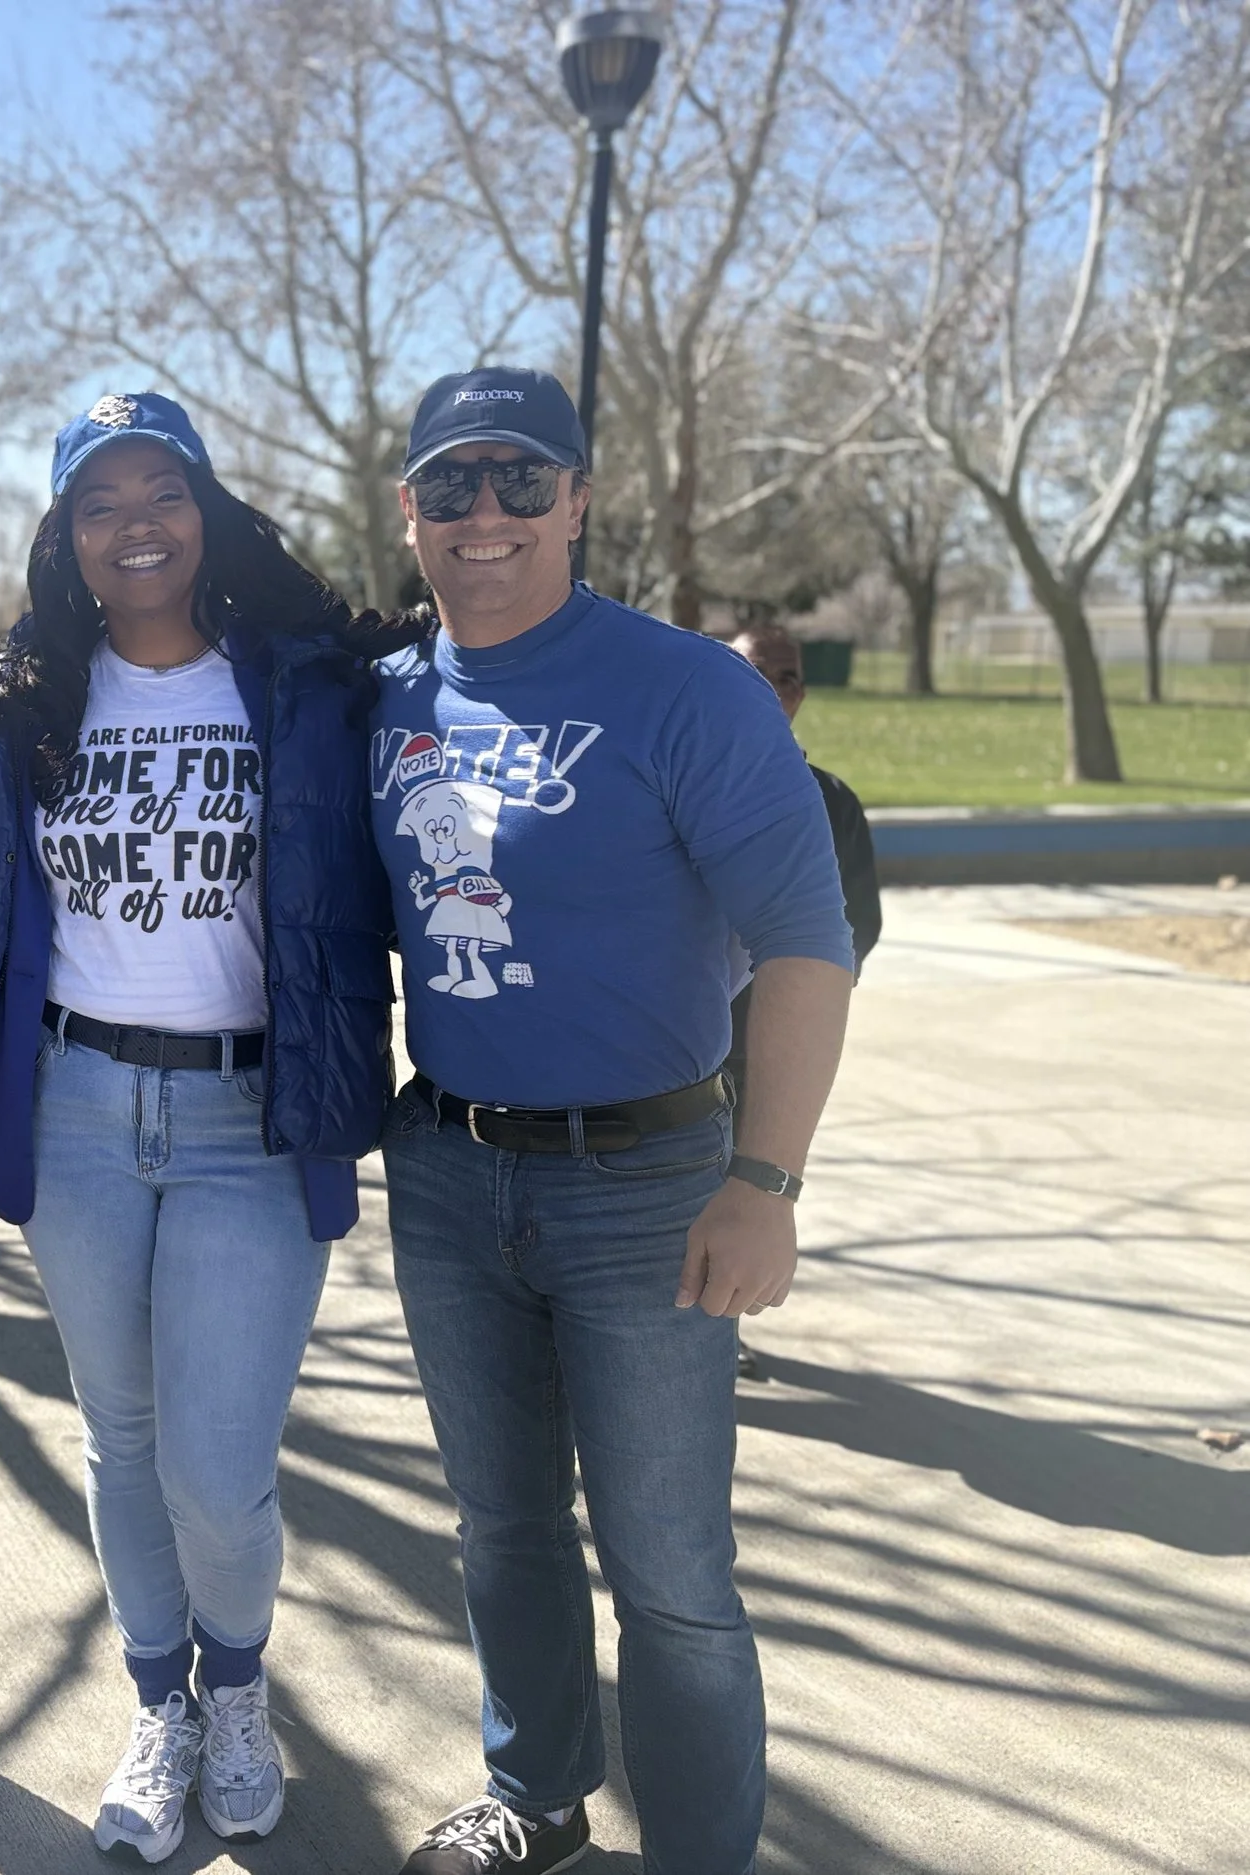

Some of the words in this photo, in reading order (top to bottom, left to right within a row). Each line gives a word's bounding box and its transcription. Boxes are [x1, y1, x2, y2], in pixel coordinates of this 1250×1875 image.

[86, 727, 126, 746] ARE
[68, 750, 157, 796] OME
[177, 746, 262, 796] FOR
[400, 750, 438, 775] VOTE
[43, 795, 118, 829] one
[130, 784, 183, 835] of
[41, 832, 153, 884] COME
[174, 830, 257, 882] FOR
[67, 879, 110, 920] all
[120, 879, 168, 933] of
[462, 877, 501, 894] BILL
